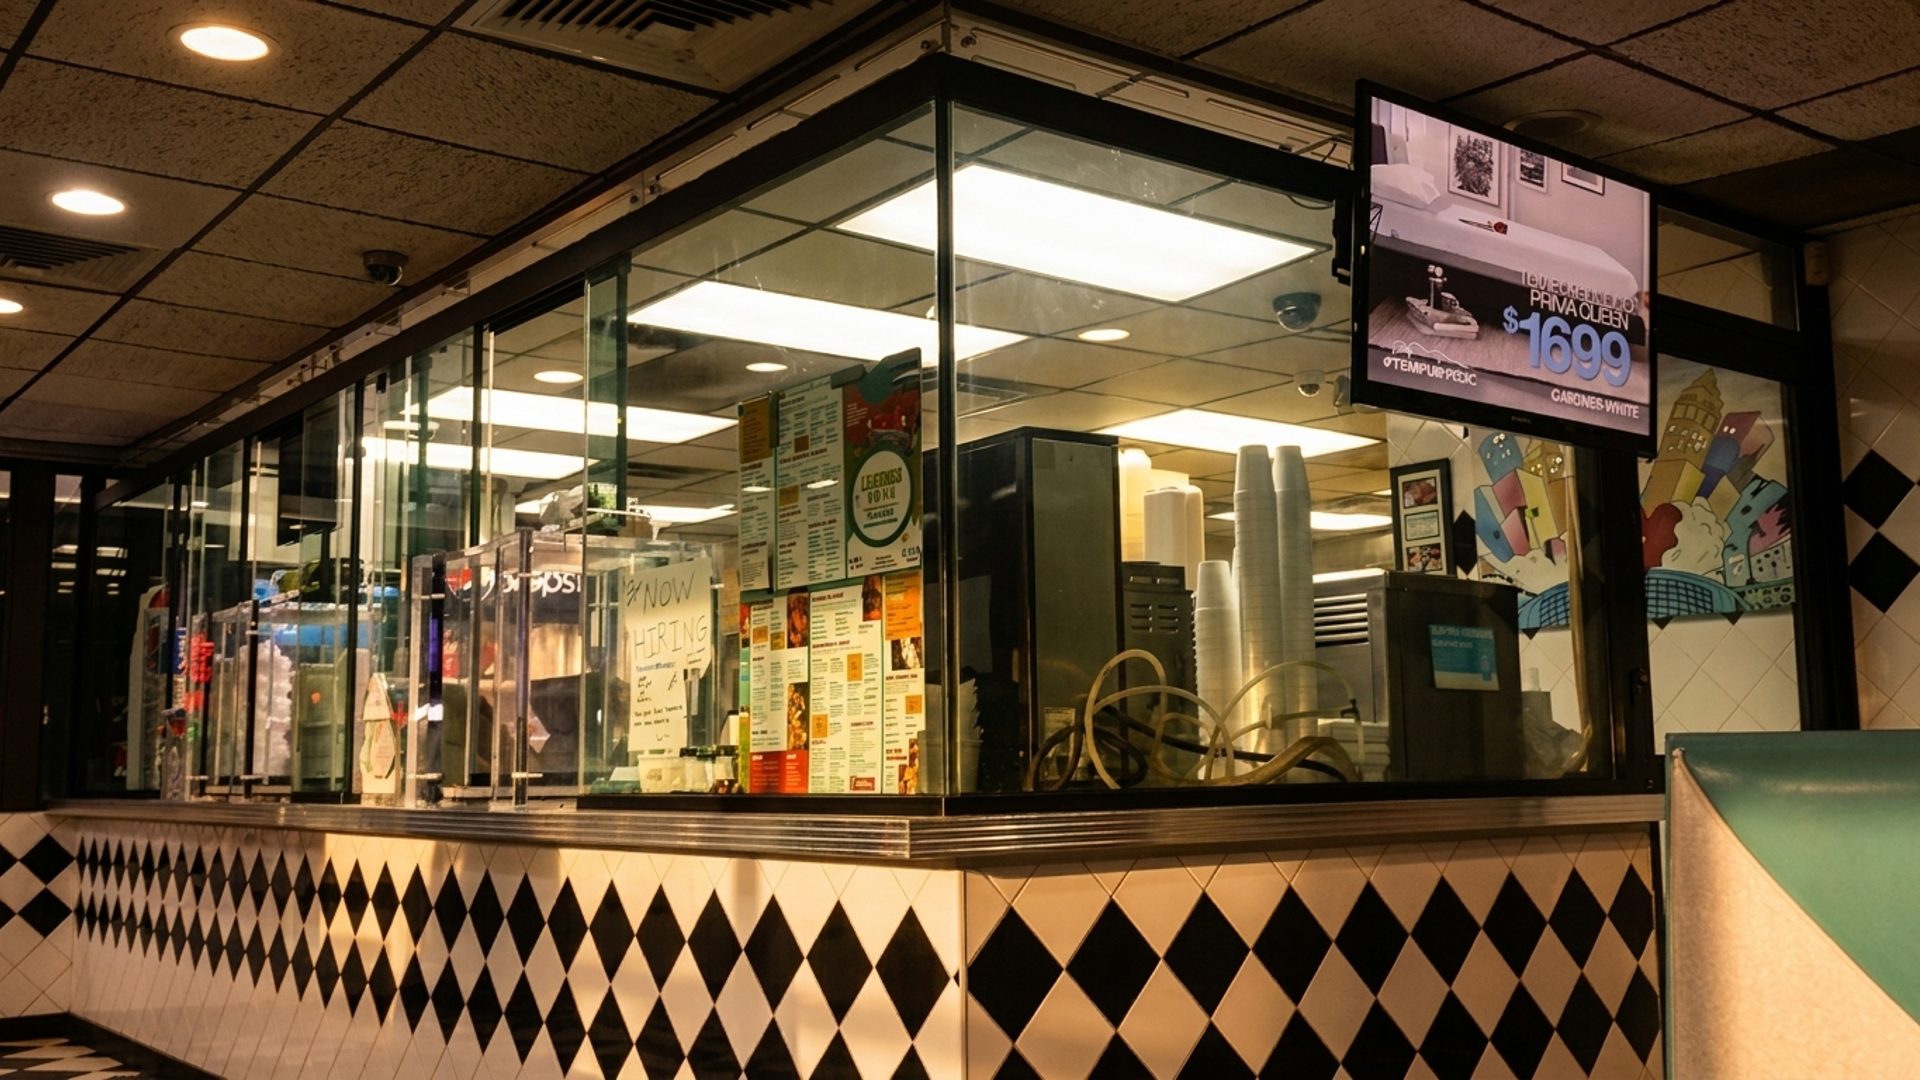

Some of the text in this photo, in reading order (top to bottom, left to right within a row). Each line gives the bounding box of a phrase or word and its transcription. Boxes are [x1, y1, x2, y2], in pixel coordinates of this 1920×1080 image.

[1503, 304, 1632, 388] $1699
[502, 571, 582, 598] psi
[642, 569, 696, 614] NOW
[633, 614, 708, 660] HIRING
